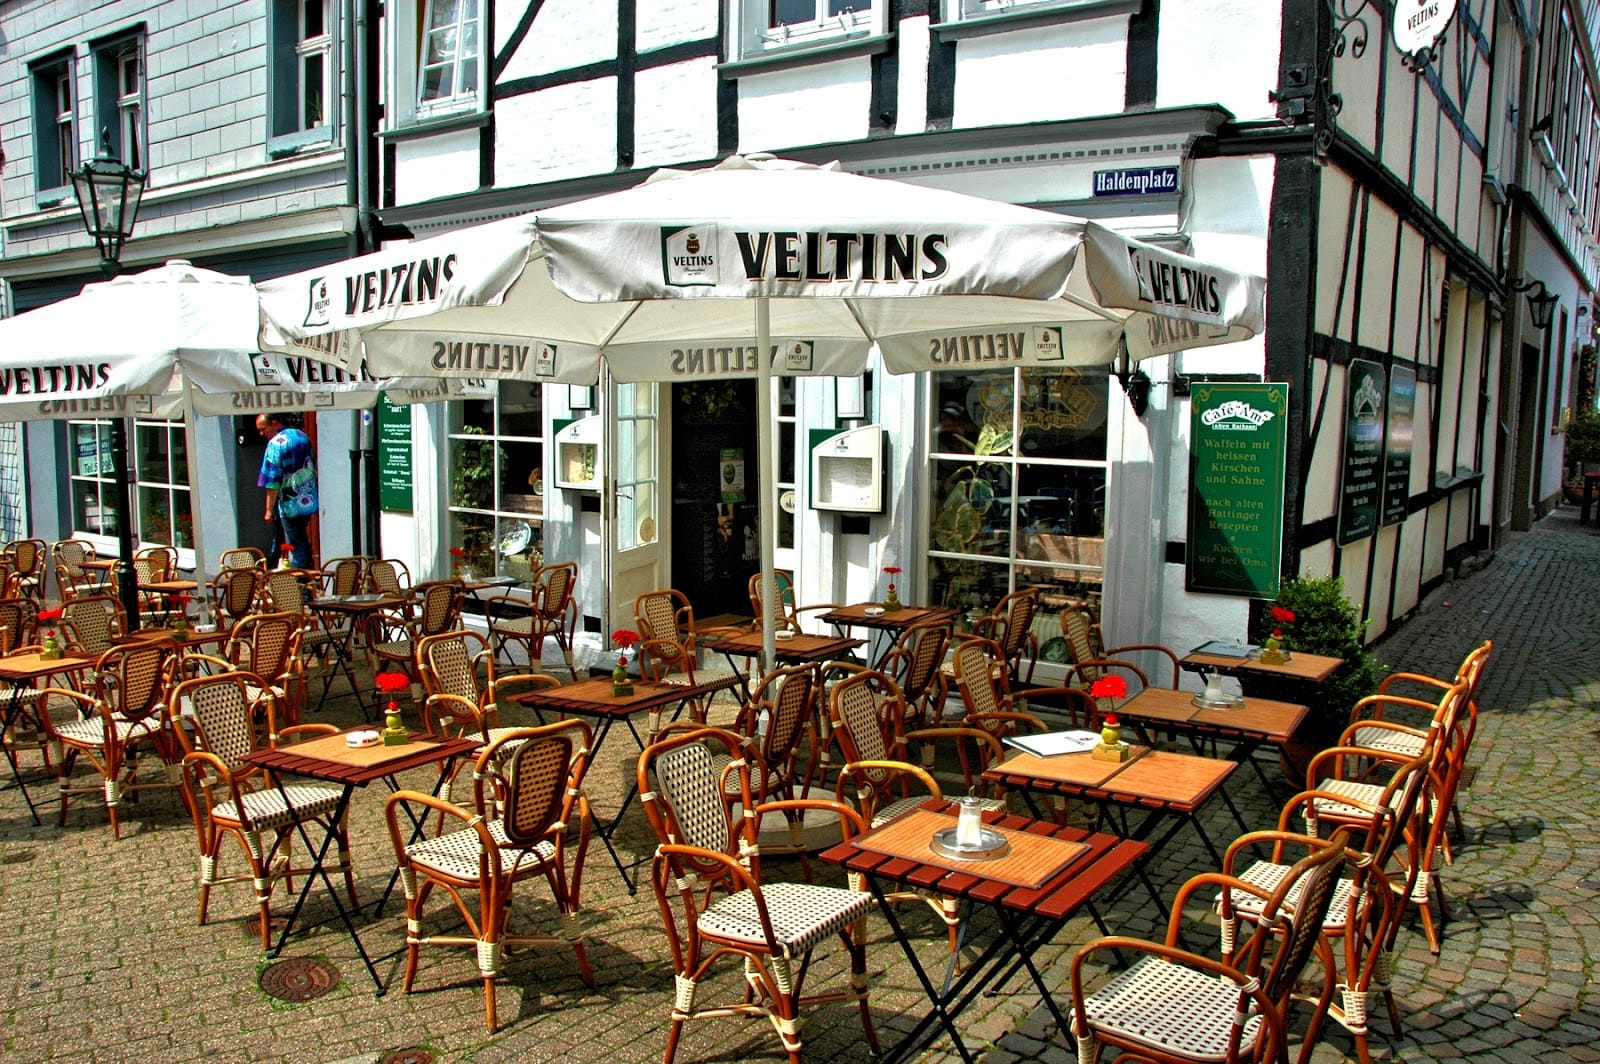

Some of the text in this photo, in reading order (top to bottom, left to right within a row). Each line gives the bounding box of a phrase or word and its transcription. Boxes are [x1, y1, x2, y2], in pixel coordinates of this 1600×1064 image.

[1408, 2, 1438, 31] VELTINS
[1097, 169, 1175, 194] Haldenplatz
[673, 255, 714, 267] VELTINS
[735, 231, 949, 283] VELTINS
[345, 252, 458, 318] VELTINS
[1149, 260, 1221, 316] VELTINS
[0, 362, 111, 396] VELTINS
[1204, 439, 1271, 449] Waffeln mit
[1216, 451, 1257, 461] heissen
[1211, 462, 1260, 473] Kirschen
[1206, 475, 1266, 486] und Sahne
[1205, 498, 1264, 509] nach alten
[1208, 508, 1261, 521] Hattinger
[1209, 520, 1259, 532] Rezepten
[1213, 543, 1253, 554] Kuchen
[1198, 555, 1268, 568] wie bei Oma
